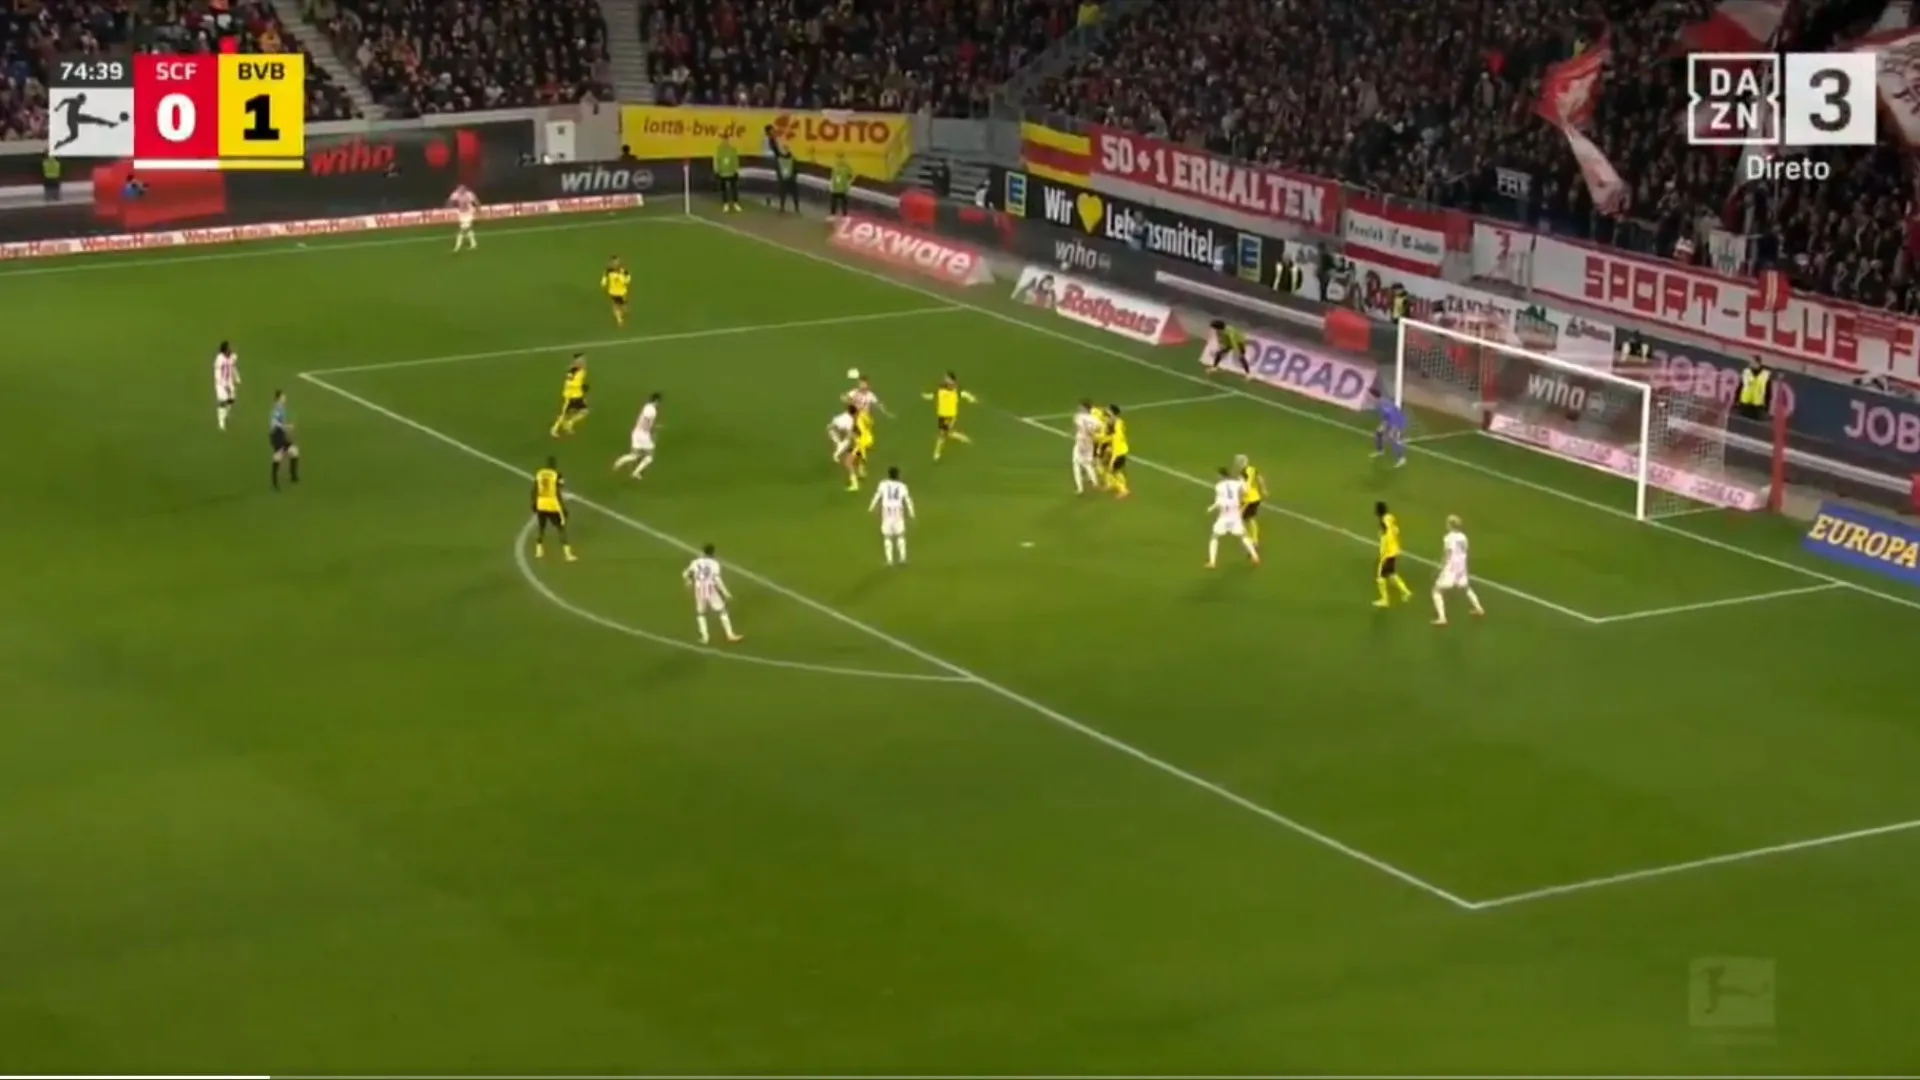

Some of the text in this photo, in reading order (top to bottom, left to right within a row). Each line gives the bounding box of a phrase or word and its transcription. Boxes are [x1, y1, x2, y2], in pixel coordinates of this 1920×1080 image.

[804, 117, 890, 144] LOTTO
[561, 166, 630, 192] wiha
[1044, 186, 1074, 225] Wir
[1171, 151, 1325, 224] ERHALTEN
[835, 216, 971, 275] Lexware
[1062, 282, 1161, 335] Rothaus
[1807, 513, 1920, 569] EUROPA
